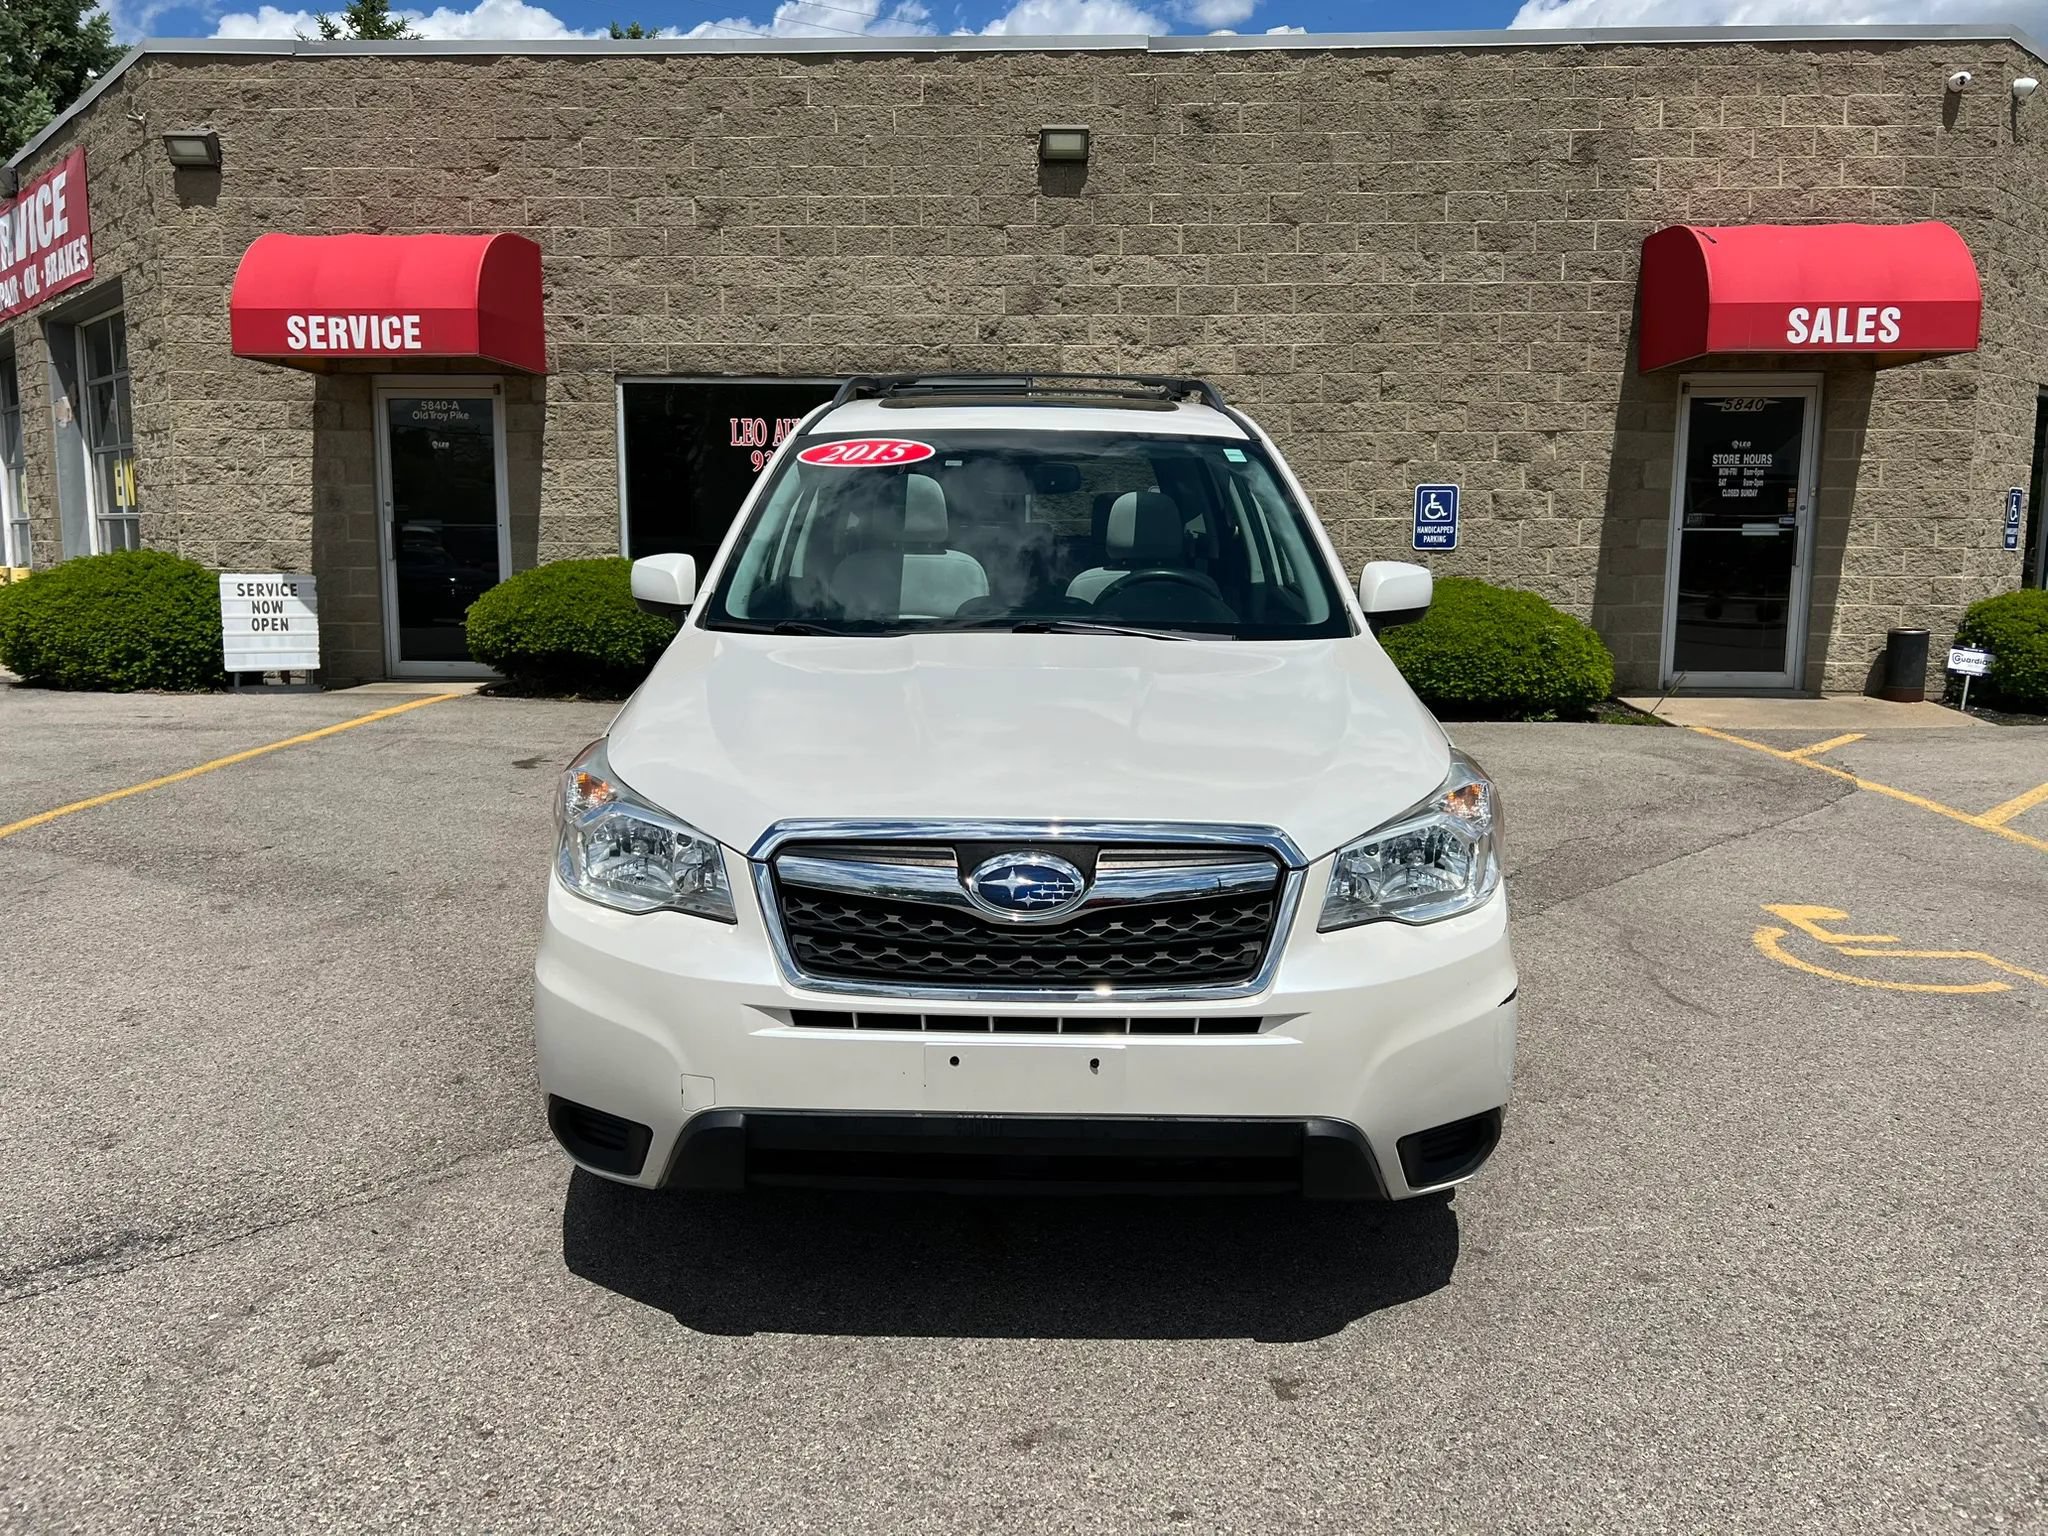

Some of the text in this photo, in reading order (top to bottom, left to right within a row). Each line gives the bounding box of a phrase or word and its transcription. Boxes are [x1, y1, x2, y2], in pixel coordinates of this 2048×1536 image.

[44, 234, 89, 288] BRAKES
[287, 315, 422, 350] SERVICE
[1786, 307, 1901, 344] SALES
[421, 401, 460, 410] 5840-A
[1723, 399, 1765, 411] 5840
[412, 410, 470, 422] Old Troy Pike
[730, 417, 768, 447] LEO
[818, 443, 914, 463] 2015
[1712, 454, 1773, 465] STORE HOURS
[1721, 489, 1759, 497] CLOSED SUNDAY
[1416, 526, 1454, 534] HANDICAPPED
[1423, 535, 1447, 543] PARKING
[236, 583, 298, 597] SERVICE
[251, 600, 284, 615] NOW
[251, 617, 289, 632] OPEN
